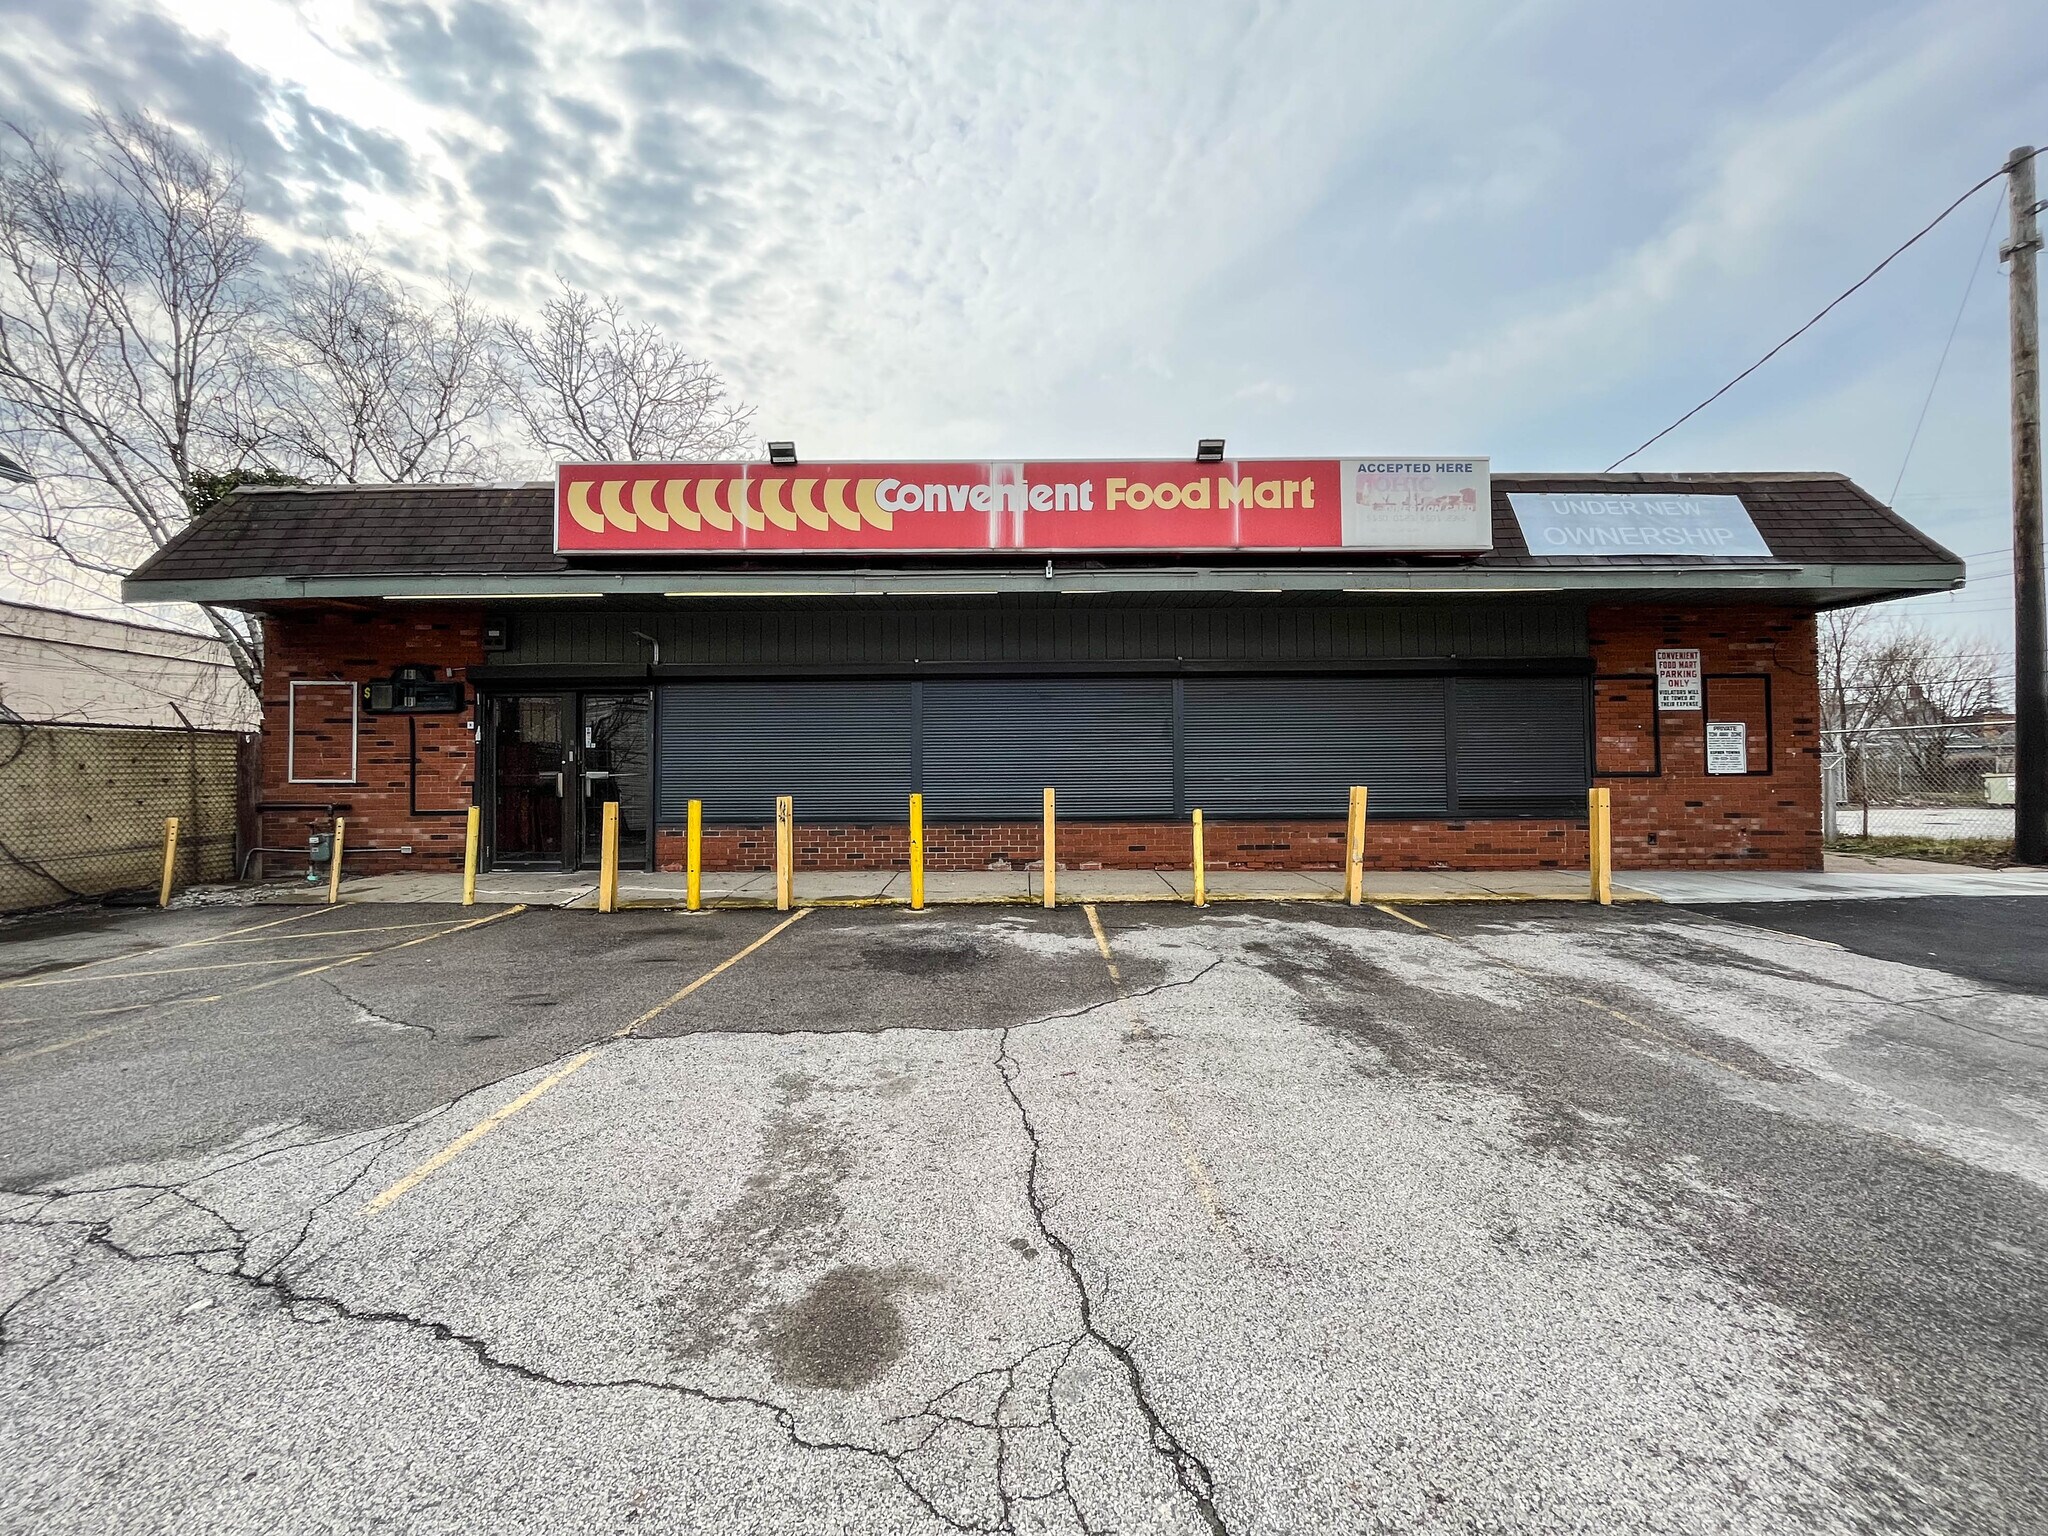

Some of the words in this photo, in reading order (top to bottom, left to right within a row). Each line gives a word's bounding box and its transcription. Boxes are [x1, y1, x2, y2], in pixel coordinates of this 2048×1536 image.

[1357, 463, 1431, 473] ACCEPTED
[1436, 463, 1473, 473] HERE
[875, 478, 1094, 512] Convenient
[1106, 477, 1211, 511] Food
[1218, 476, 1315, 509] Mart
[1551, 500, 1638, 516] UNDER
[1647, 501, 1702, 516] NEW
[1543, 526, 1735, 547] OWNERSHIP
[1657, 652, 1699, 660] CONVENIENT
[1659, 661, 1677, 669] FOOD
[1679, 661, 1697, 669] MART
[1660, 670, 1697, 678] PARKING
